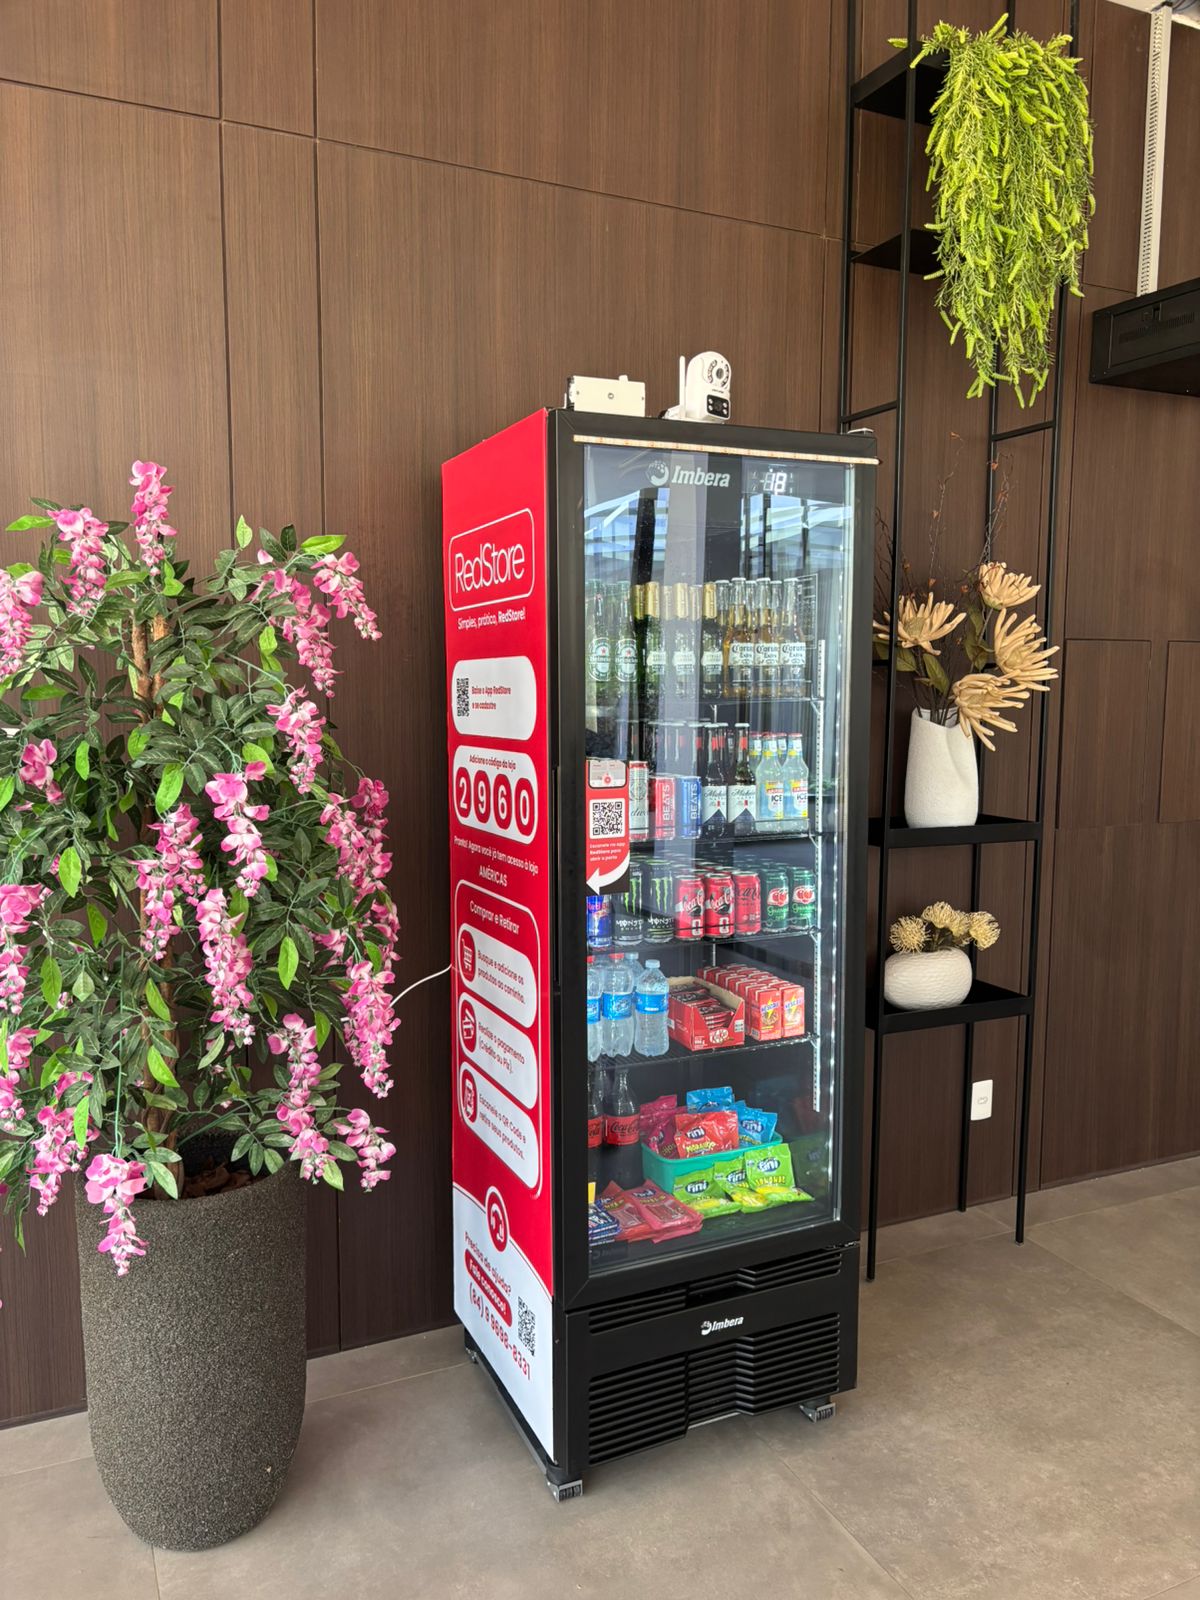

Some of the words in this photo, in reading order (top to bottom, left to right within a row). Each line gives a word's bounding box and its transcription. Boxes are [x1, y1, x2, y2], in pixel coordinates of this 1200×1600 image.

[671, 465, 731, 488] Imbera
[455, 543, 525, 594] RedStore
[498, 607, 526, 624] RedStore!
[662, 784, 671, 821] BEATS
[690, 783, 698, 820] BEATS
[479, 864, 508, 887] AMÉRICAS
[470, 900, 494, 922] Comprar
[499, 913, 520, 935] Retirar
[616, 919, 644, 927] MONST
[712, 1316, 744, 1332] Imbera
